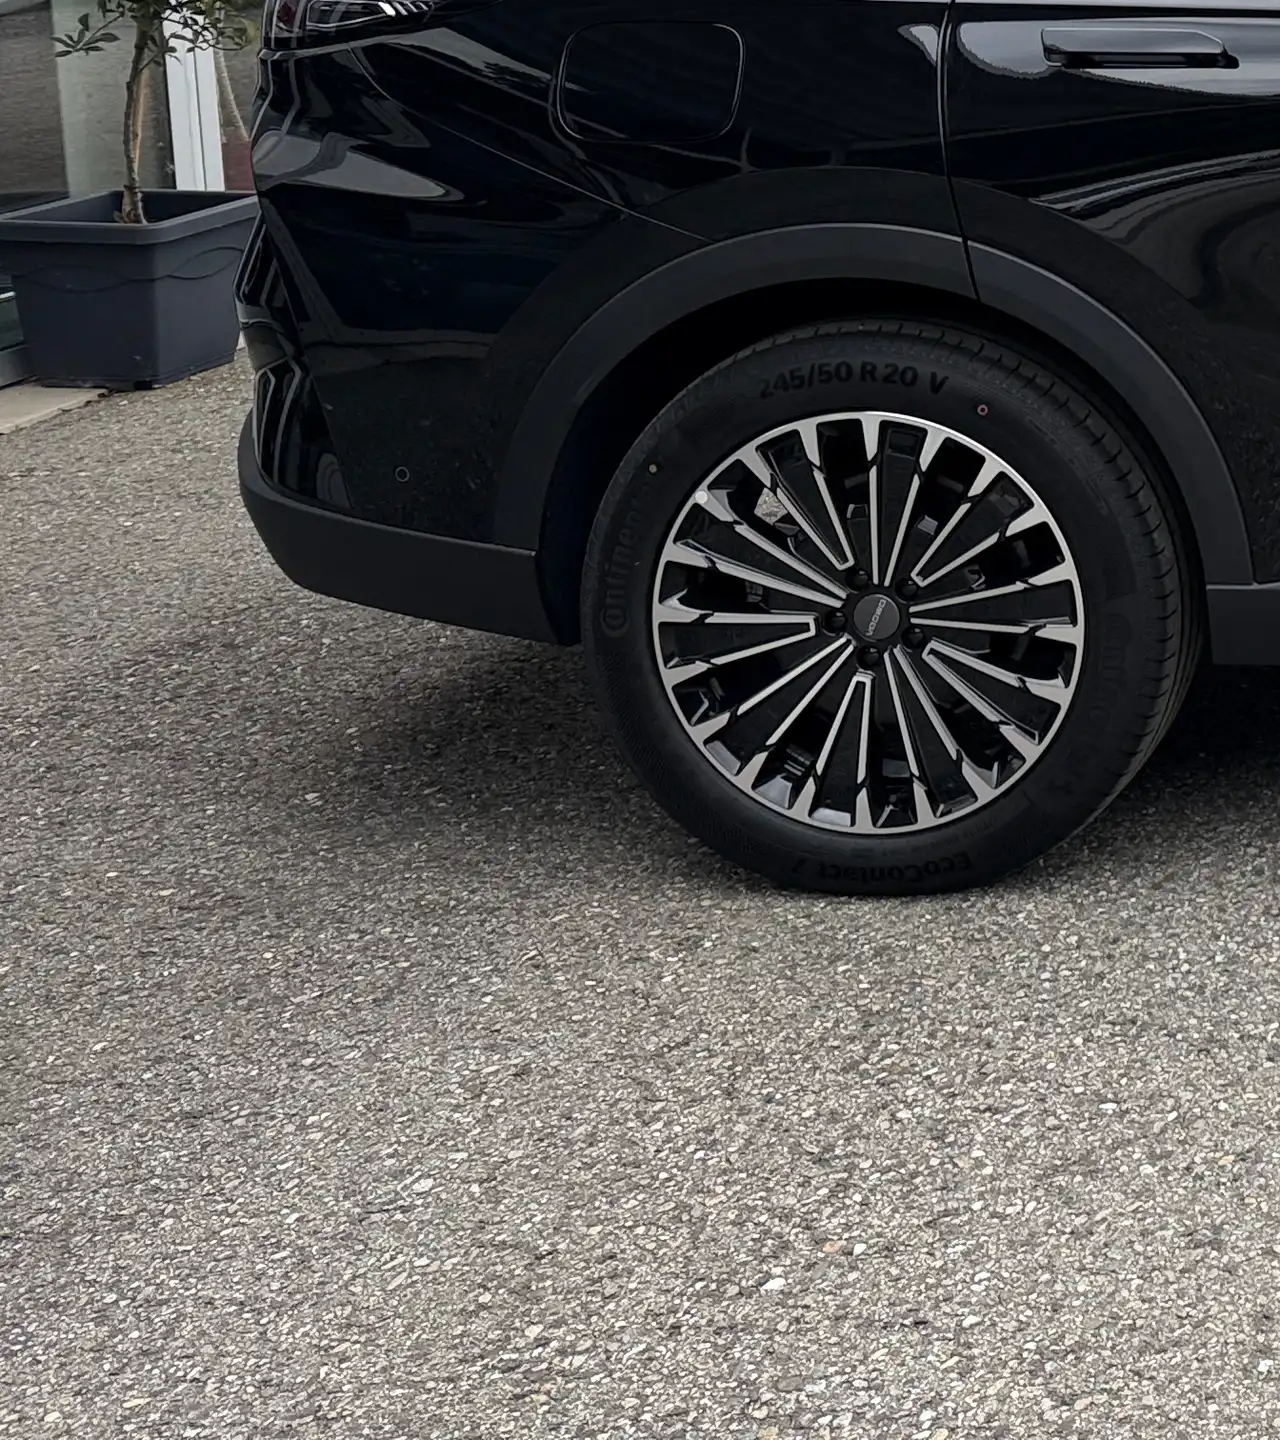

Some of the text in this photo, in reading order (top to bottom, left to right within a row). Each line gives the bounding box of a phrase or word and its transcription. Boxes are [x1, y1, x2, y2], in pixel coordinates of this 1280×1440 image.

[758, 361, 854, 399] 245/50
[928, 372, 949, 396] V
[865, 598, 887, 636] OMODA
[817, 850, 973, 885] EcoContact
